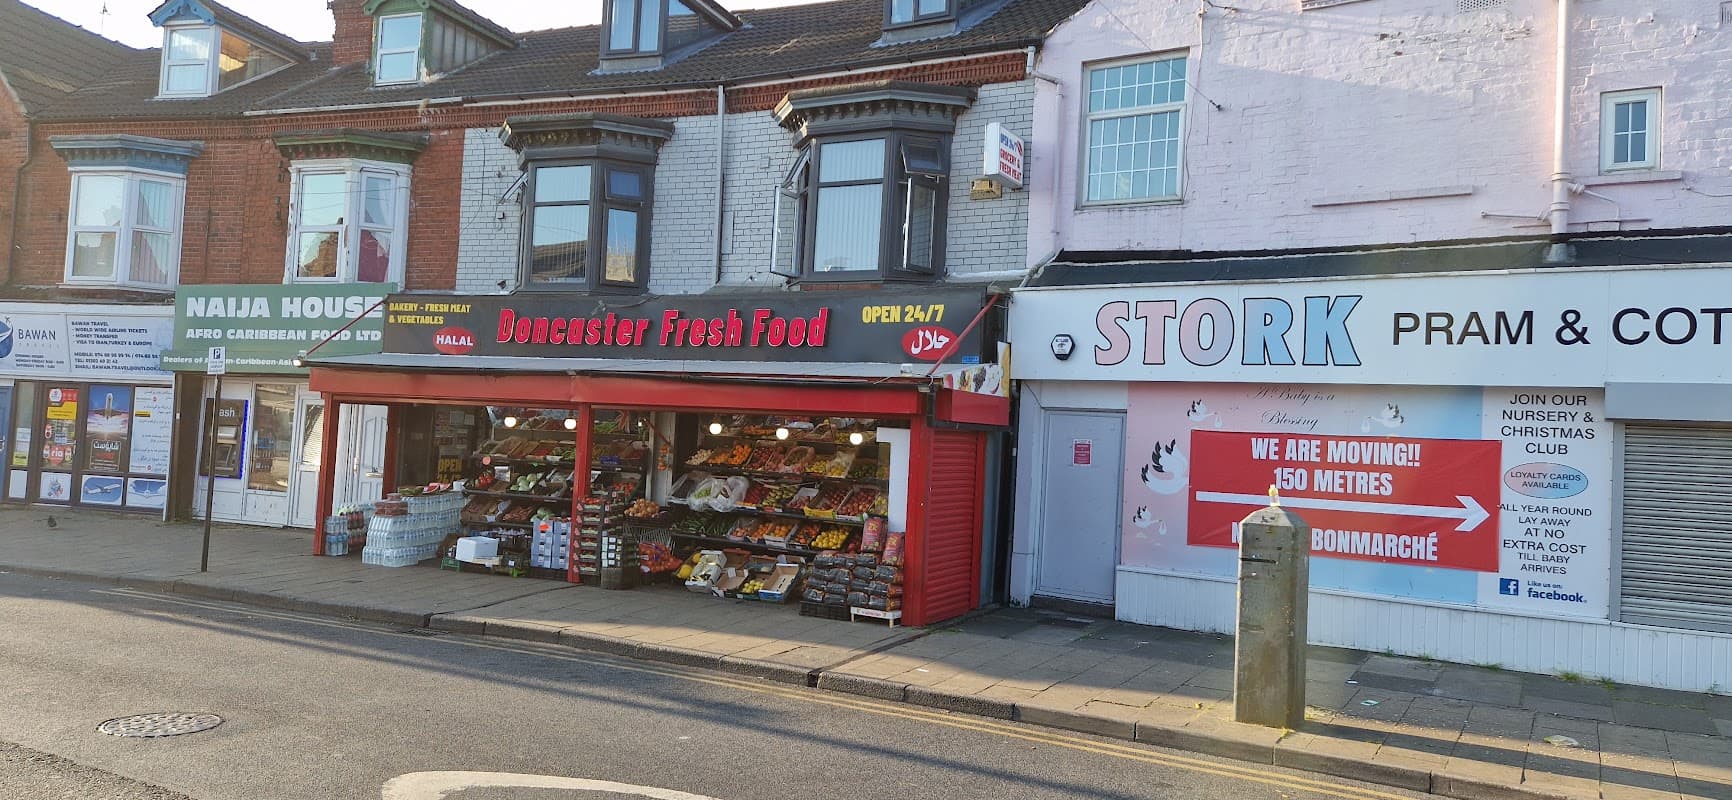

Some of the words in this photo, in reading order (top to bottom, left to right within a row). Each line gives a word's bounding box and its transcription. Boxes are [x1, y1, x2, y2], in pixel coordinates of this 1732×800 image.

[186, 296, 270, 318] NAIJA
[281, 296, 383, 318] HOUSE
[389, 302, 418, 312] BAKERY
[425, 303, 449, 313] FRESH
[450, 303, 471, 313] MEAT
[862, 305, 900, 323] OPEN
[904, 304, 945, 323] 24/7
[398, 315, 444, 325] VEGETABLES
[496, 308, 649, 346] Doncaster
[658, 308, 744, 347] Fresh
[750, 306, 830, 347] Food
[1392, 310, 1534, 346] PRAM
[1555, 309, 1591, 346] &
[1612, 307, 1732, 345] COT
[18, 328, 56, 341] BAWAN
[186, 329, 222, 340] AFRO
[227, 329, 307, 341] CARIBBEAN
[311, 330, 351, 341] FOOD
[356, 330, 382, 341] LTD
[1094, 295, 1363, 367] STORK
[435, 335, 474, 347] HALAL
[911, 330, 950, 355] حلال
[163, 356, 193, 364] Dealers
[1275, 384, 1311, 406] Baby
[1510, 394, 1546, 405] JOIN
[1551, 394, 1587, 406] OUR
[218, 406, 235, 417] ash
[1502, 409, 1578, 422] NURSERY
[1583, 411, 1594, 423] &
[1261, 410, 1319, 432] Blessing
[1501, 425, 1595, 440] CHRISTMAS
[1251, 437, 1280, 461] WE
[1284, 438, 1321, 463] ARE
[1327, 440, 1421, 467] MOVING!!
[1525, 442, 1568, 455] CLUB
[438, 457, 462, 472] OPEN
[1273, 467, 1308, 492] 150
[1313, 470, 1393, 497] METRES
[1511, 471, 1548, 480] LOYALTY
[1549, 473, 1581, 482] CARDS
[1521, 480, 1569, 490] AVAILABLE
[1499, 503, 1518, 511] ALL
[1521, 505, 1549, 513] YEAR
[1552, 507, 1592, 516] ROUND
[1518, 516, 1538, 525] LAY
[1540, 518, 1571, 527] AWAY
[1524, 528, 1540, 537] AT
[1545, 529, 1565, 538] NO
[1311, 528, 1438, 561] BONMARCHÉ
[1503, 539, 1545, 551] EXTRA
[1549, 543, 1587, 555] COST
[1518, 552, 1538, 561] TILL
[1541, 555, 1570, 563] BABY
[1520, 563, 1567, 575] ARRIVES
